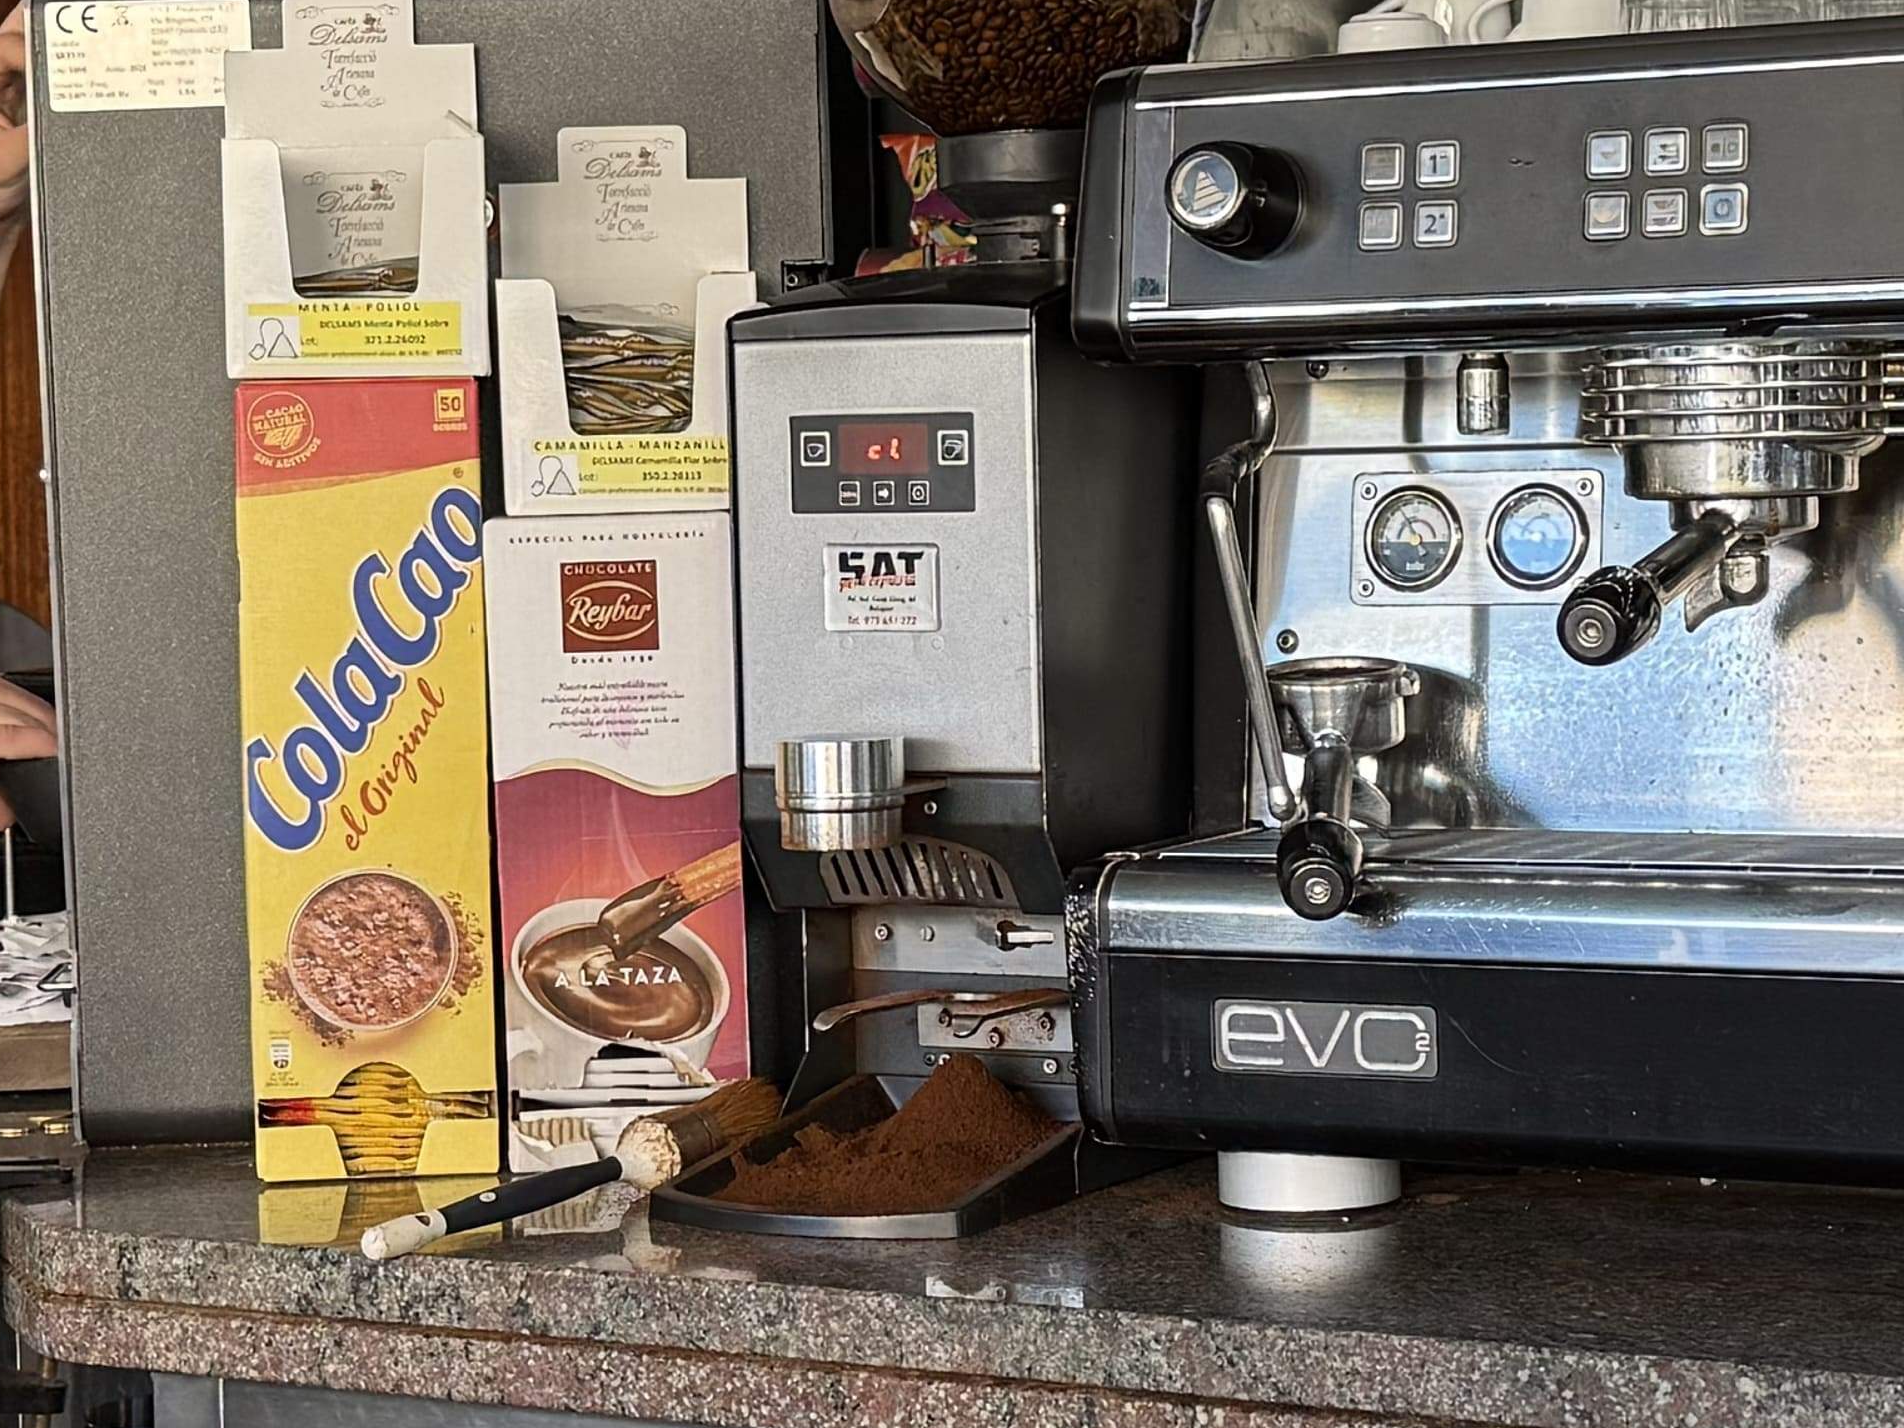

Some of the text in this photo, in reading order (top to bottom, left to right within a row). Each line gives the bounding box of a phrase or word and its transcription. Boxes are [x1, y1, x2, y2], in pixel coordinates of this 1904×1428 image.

[297, 301, 422, 313] MENTA POLIOL
[265, 402, 305, 420] CACAO
[439, 395, 462, 412] 50
[533, 440, 626, 452] CAMAMILLA
[563, 562, 653, 576] CHOCOLATE
[838, 551, 925, 586] SAT
[568, 593, 653, 631] Reybar
[246, 486, 483, 852] ColaCao
[358, 676, 446, 818] Original
[554, 966, 683, 988] A LA TAZA
